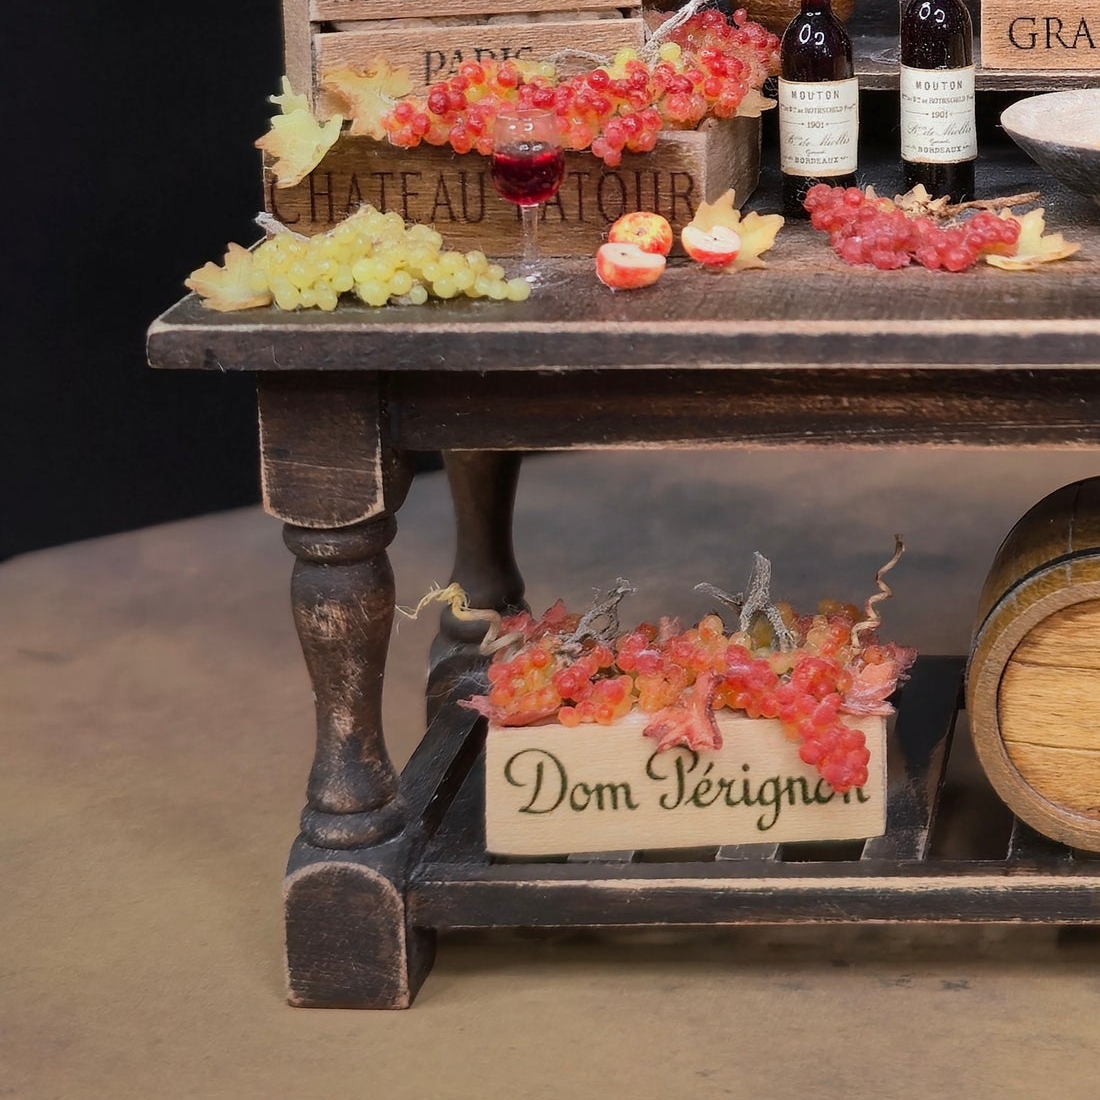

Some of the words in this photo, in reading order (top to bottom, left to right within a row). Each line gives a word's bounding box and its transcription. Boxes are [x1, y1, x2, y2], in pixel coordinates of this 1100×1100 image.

[916, 80, 963, 91] MOUTON
[791, 90, 840, 100] MOUTON
[931, 111, 948, 119] 1901
[807, 121, 824, 129] 1901
[917, 145, 962, 154] BORDEAUX
[794, 156, 840, 165] BORDEAUX
[504, 747, 639, 814] Dom
